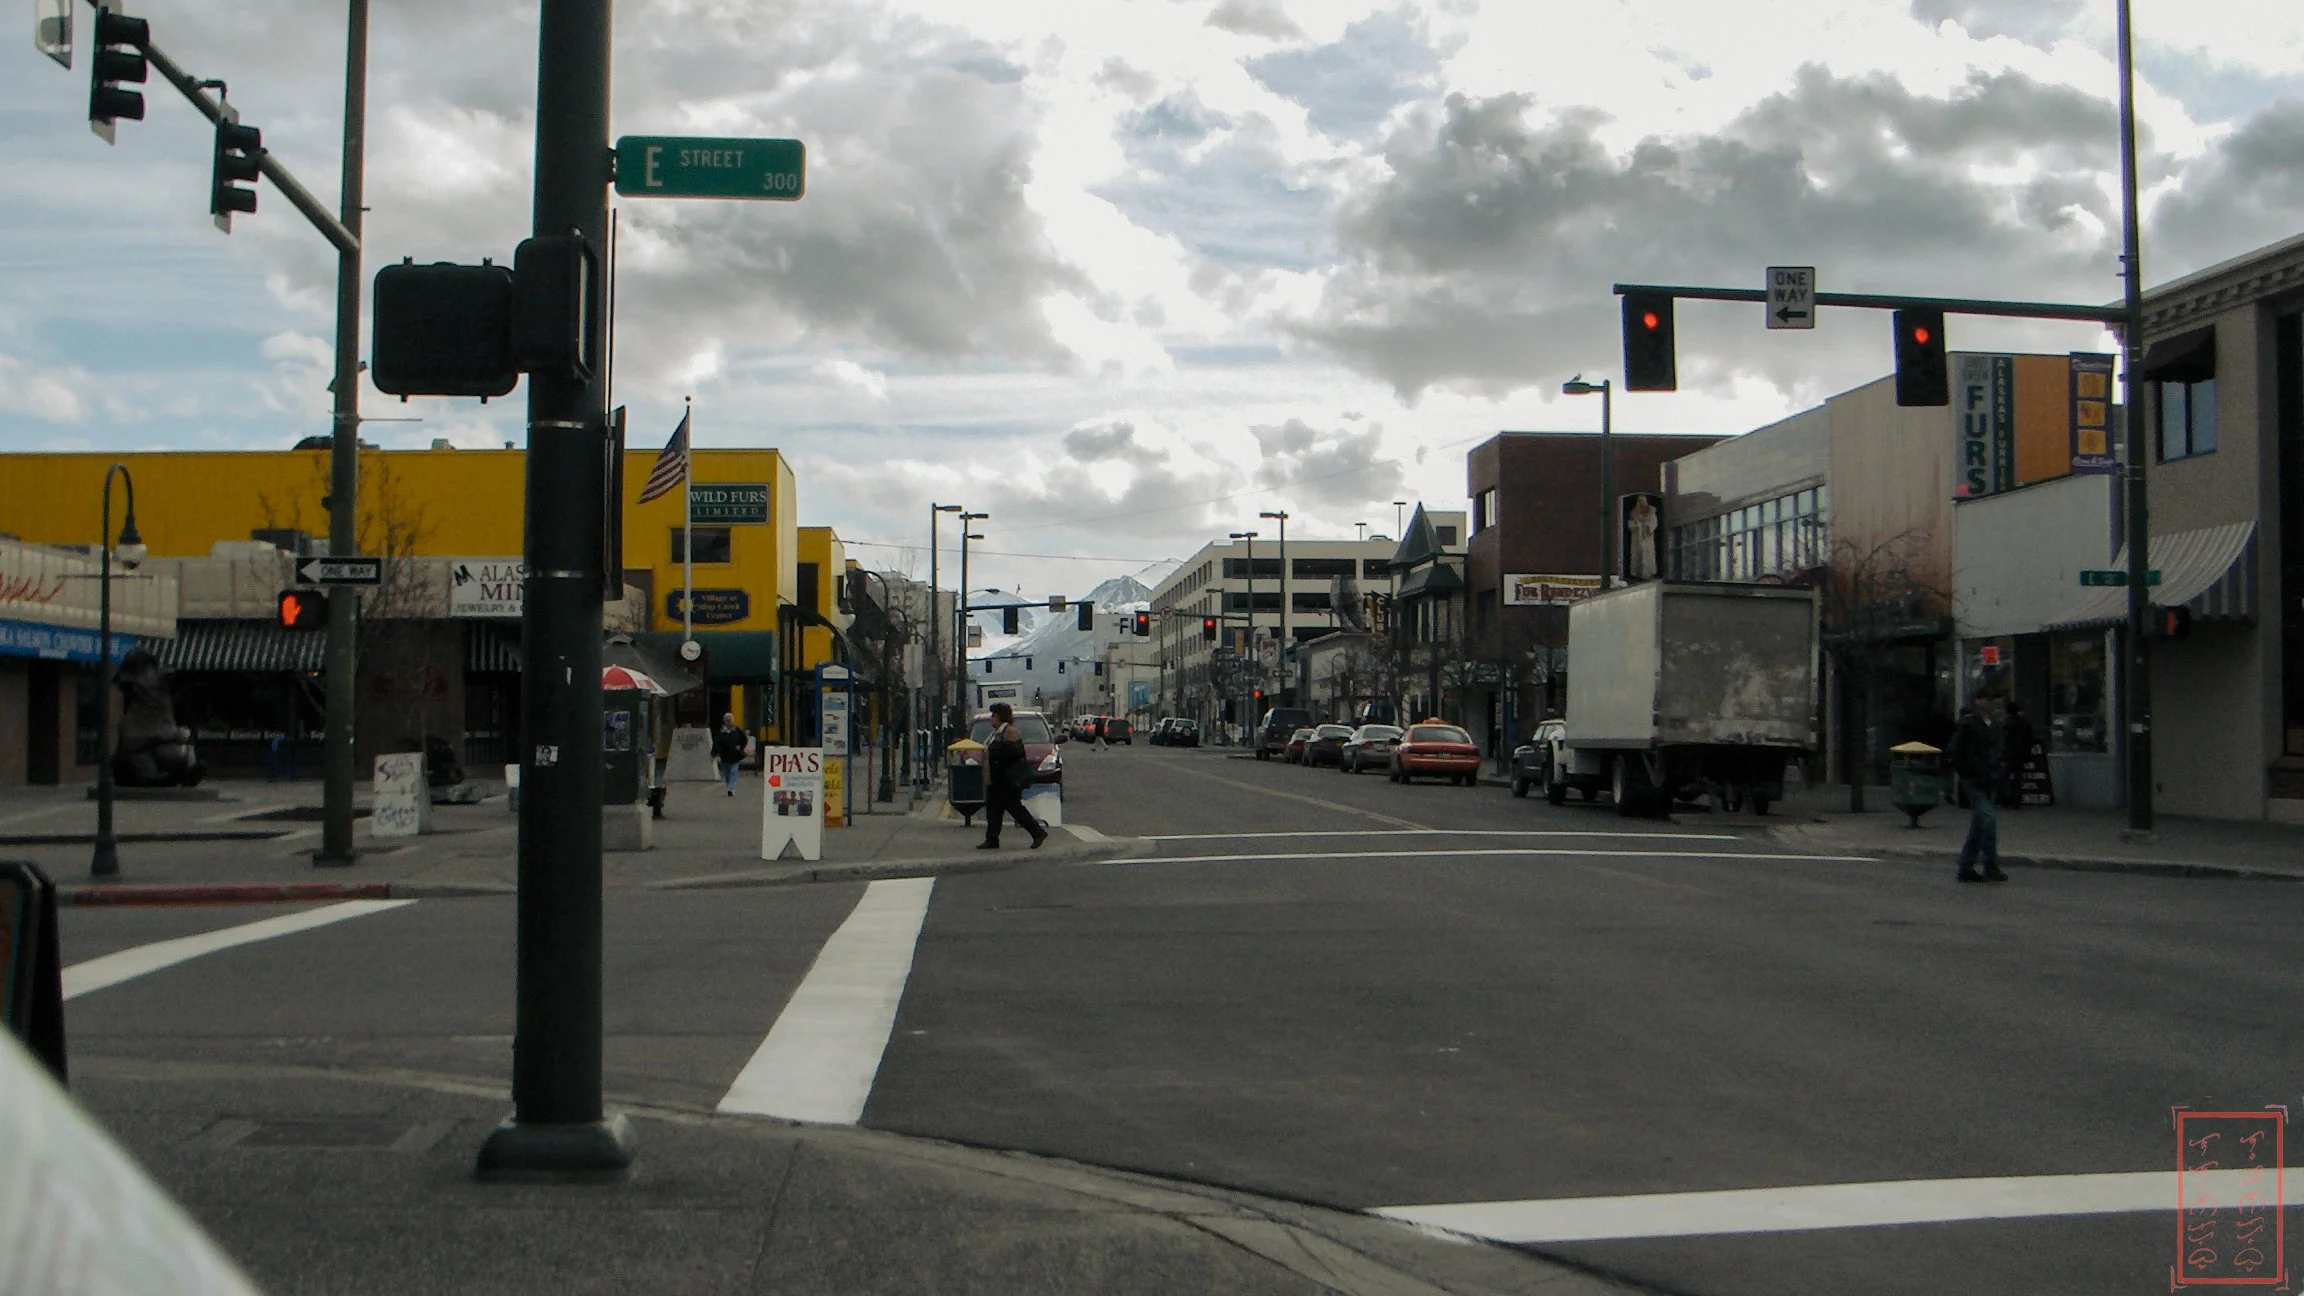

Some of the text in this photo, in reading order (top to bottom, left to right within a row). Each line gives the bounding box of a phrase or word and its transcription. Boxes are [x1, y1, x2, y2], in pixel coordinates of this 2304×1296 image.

[645, 146, 744, 187] E STREET
[763, 172, 797, 190] 300
[1776, 271, 1807, 286] ONE
[1774, 288, 1808, 302] WAY
[1964, 385, 1987, 494] FURS
[690, 490, 768, 503] WILD FURS
[696, 506, 760, 516] LIMITED
[321, 562, 373, 577] ONE WAY
[769, 752, 819, 773] PIA'S
